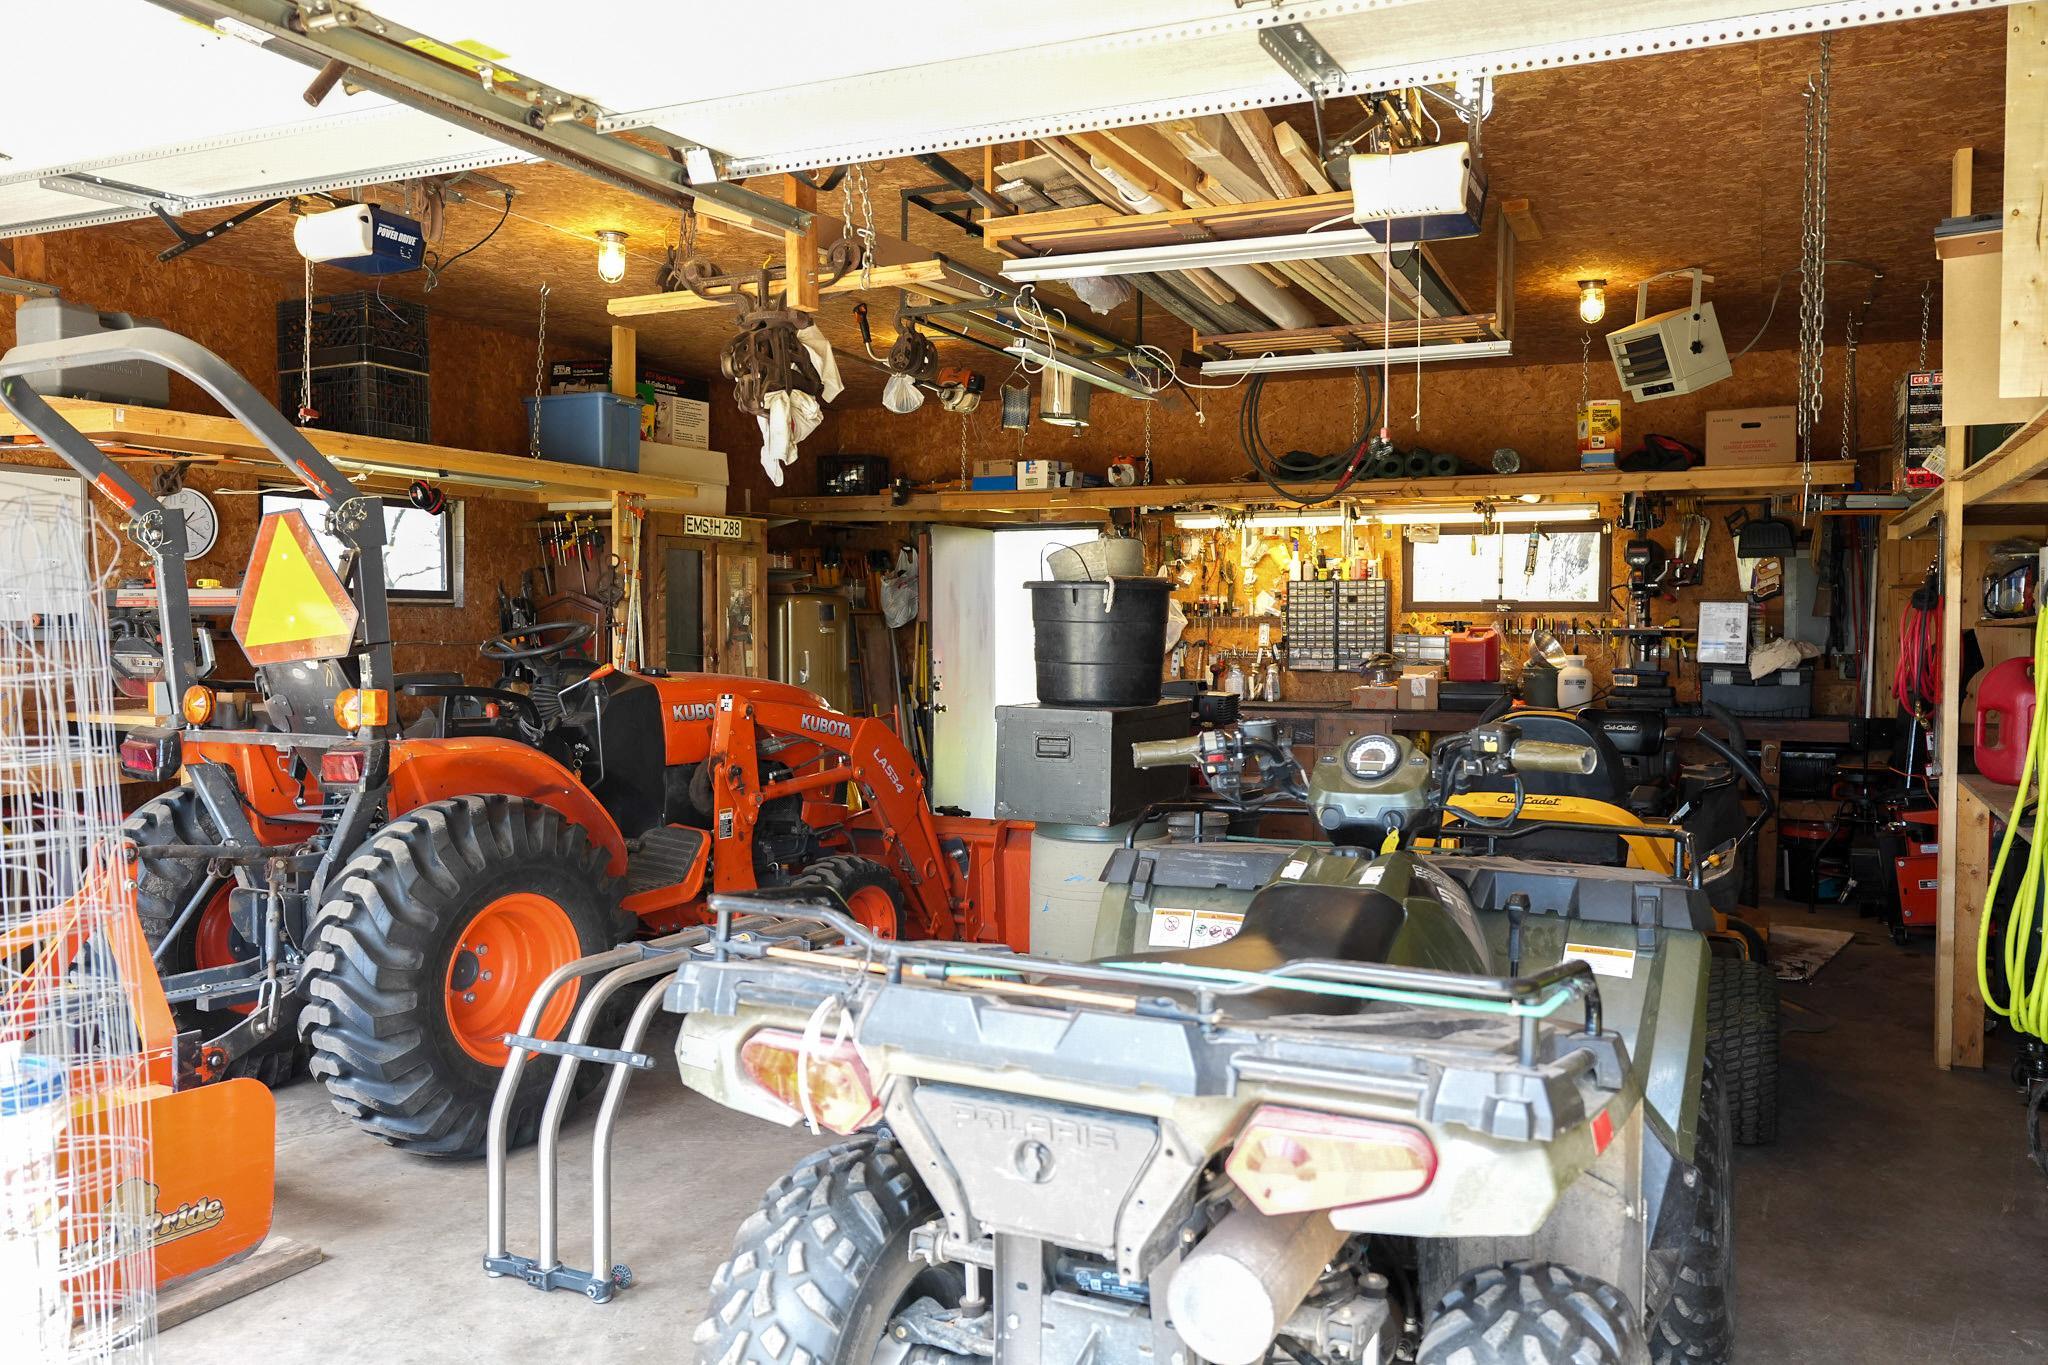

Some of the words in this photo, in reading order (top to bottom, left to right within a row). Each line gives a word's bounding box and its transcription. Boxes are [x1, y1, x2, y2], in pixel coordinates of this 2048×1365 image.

[377, 226, 399, 241] POWER
[398, 232, 417, 246] DRIVE
[666, 383, 677, 391] Tank
[1913, 376, 1943, 384] CRATS
[723, 520, 740, 536] 288
[801, 713, 851, 739] KUBOTA
[873, 748, 904, 794] LA534
[1523, 796, 1561, 806] Cadet
